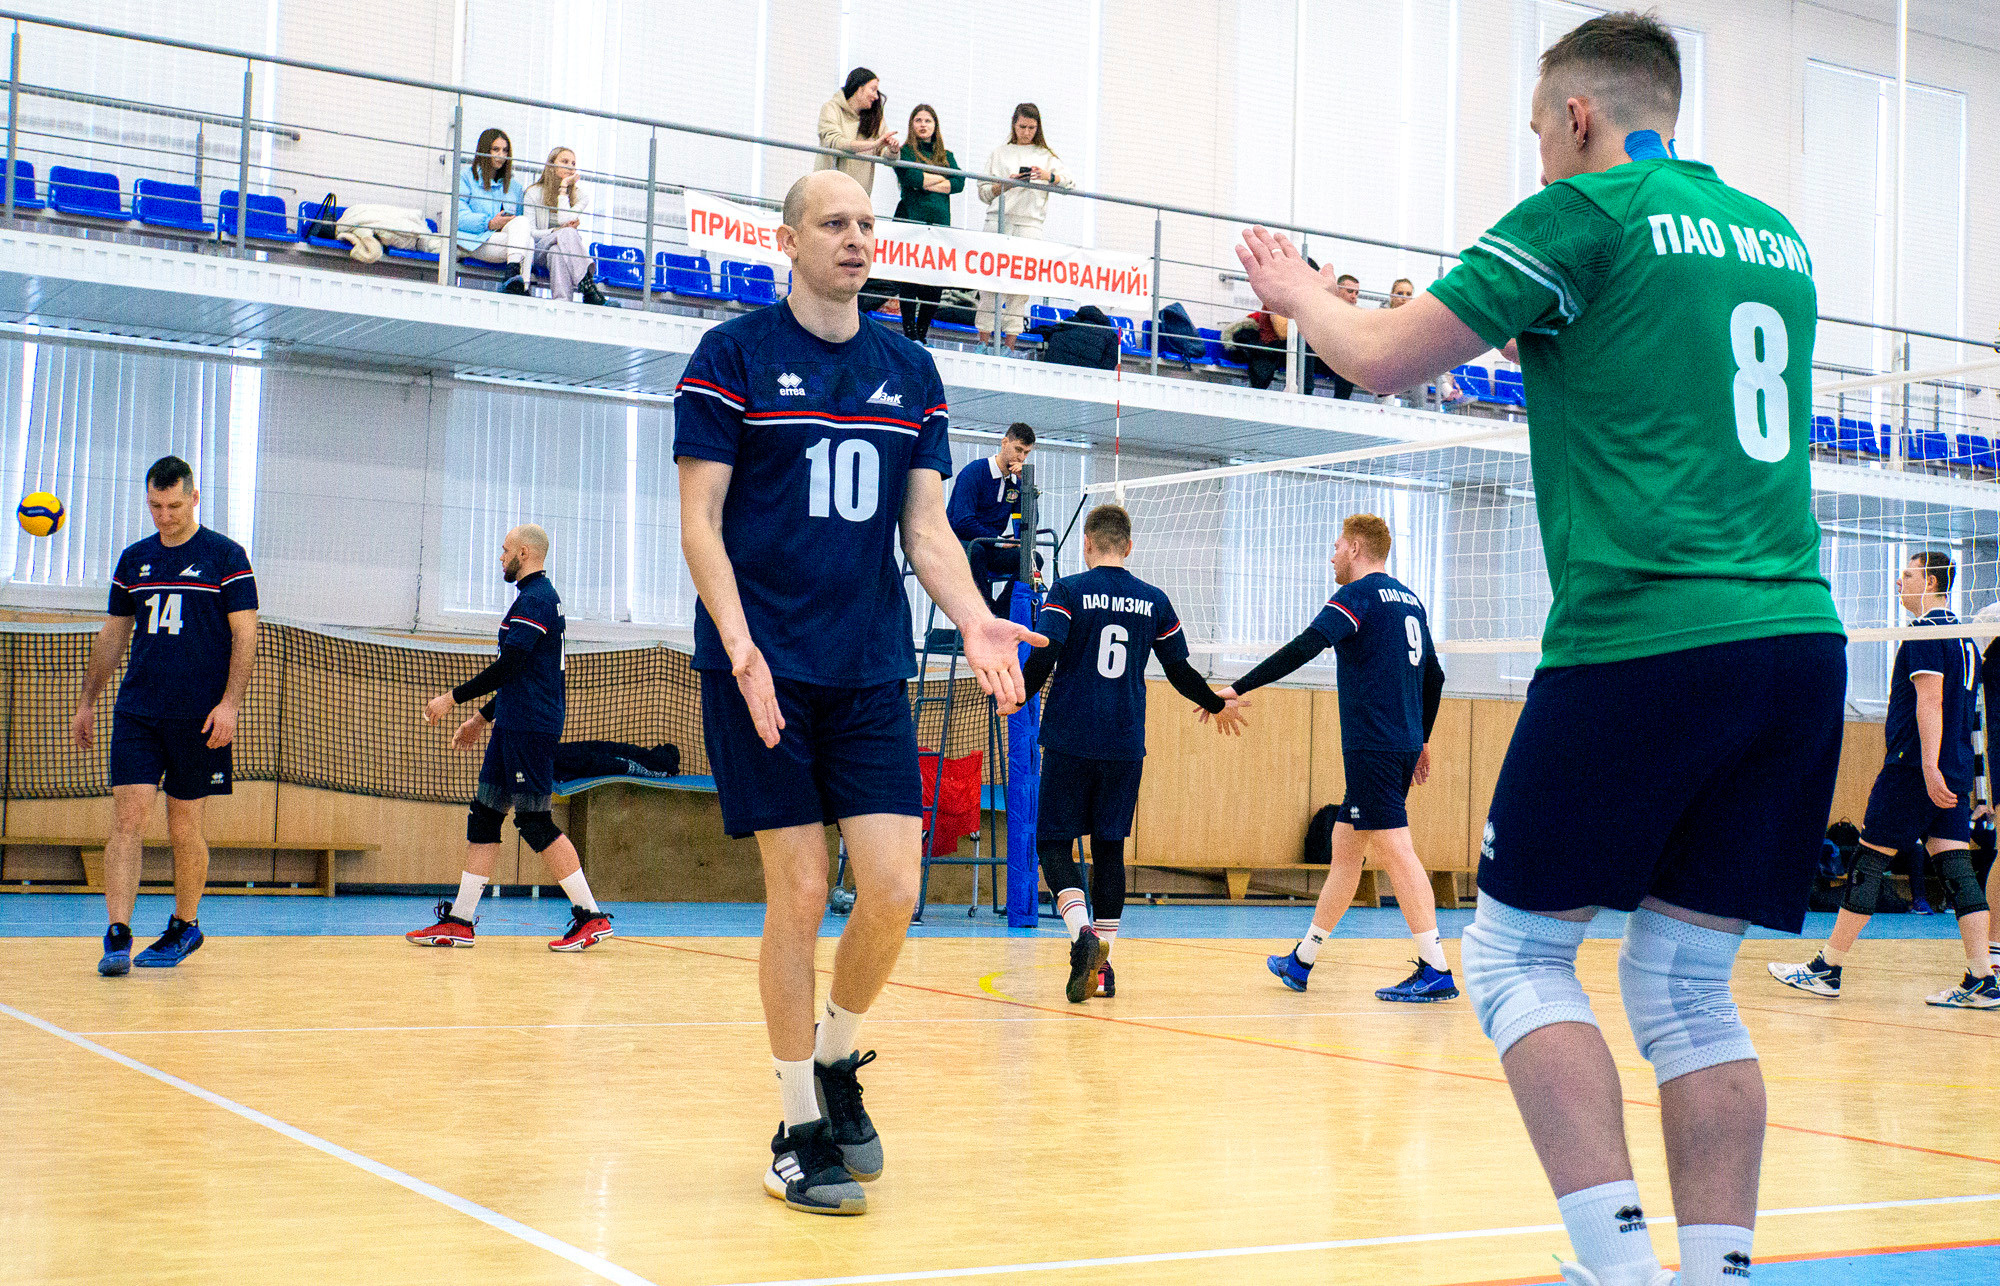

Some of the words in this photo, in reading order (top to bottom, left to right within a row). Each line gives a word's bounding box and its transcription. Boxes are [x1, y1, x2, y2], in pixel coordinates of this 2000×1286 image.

[1647, 213, 1726, 258] ПАО
[965, 249, 1148, 297] СОРЕВНОВАНИЙ!
[1729, 301, 1791, 463] 8
[805, 437, 880, 522] 10
[144, 593, 184, 635] 14
[1082, 594, 1109, 610] ПАО
[1111, 596, 1154, 618] МЗИК
[1377, 588, 1401, 603] ПАО
[1097, 624, 1129, 679] 6
[1404, 615, 1423, 667] 9
